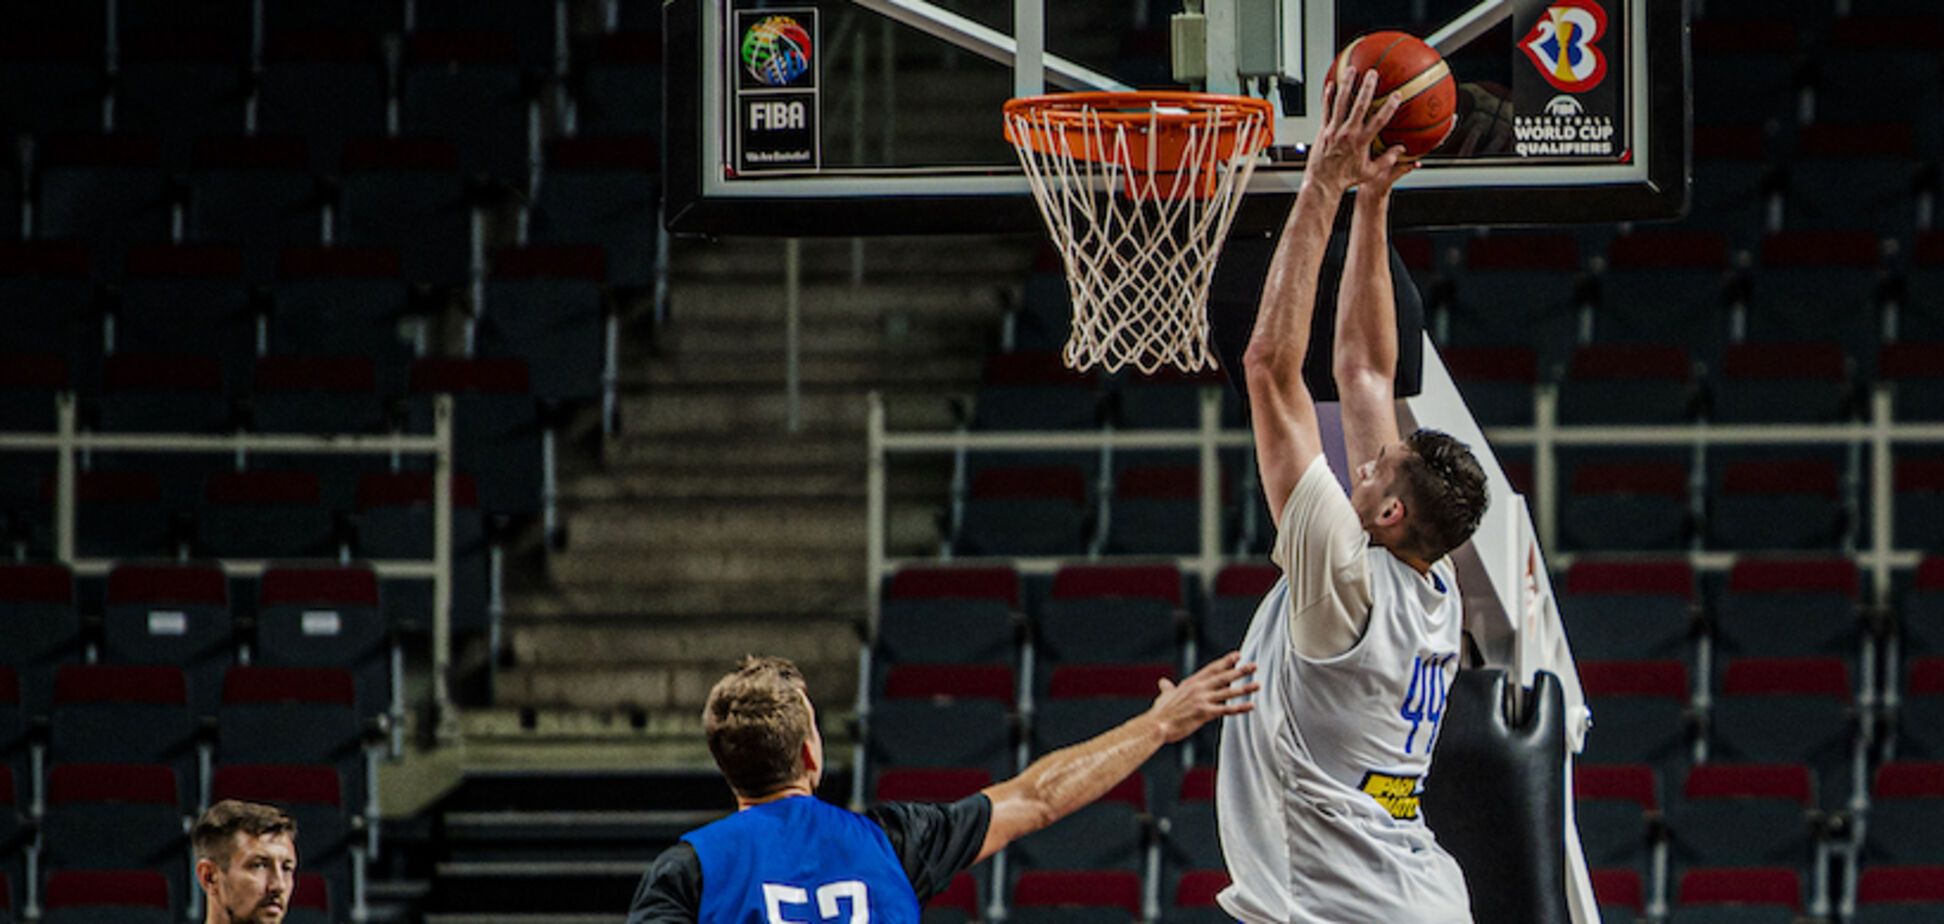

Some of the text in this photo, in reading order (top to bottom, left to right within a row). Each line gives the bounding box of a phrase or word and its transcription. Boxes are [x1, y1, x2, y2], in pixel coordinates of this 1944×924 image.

[750, 102, 805, 130] FIBA
[1514, 125, 1613, 140] WORLD CUP
[1516, 142, 1612, 156] QUALIFIERS
[1401, 653, 1456, 753] 44
